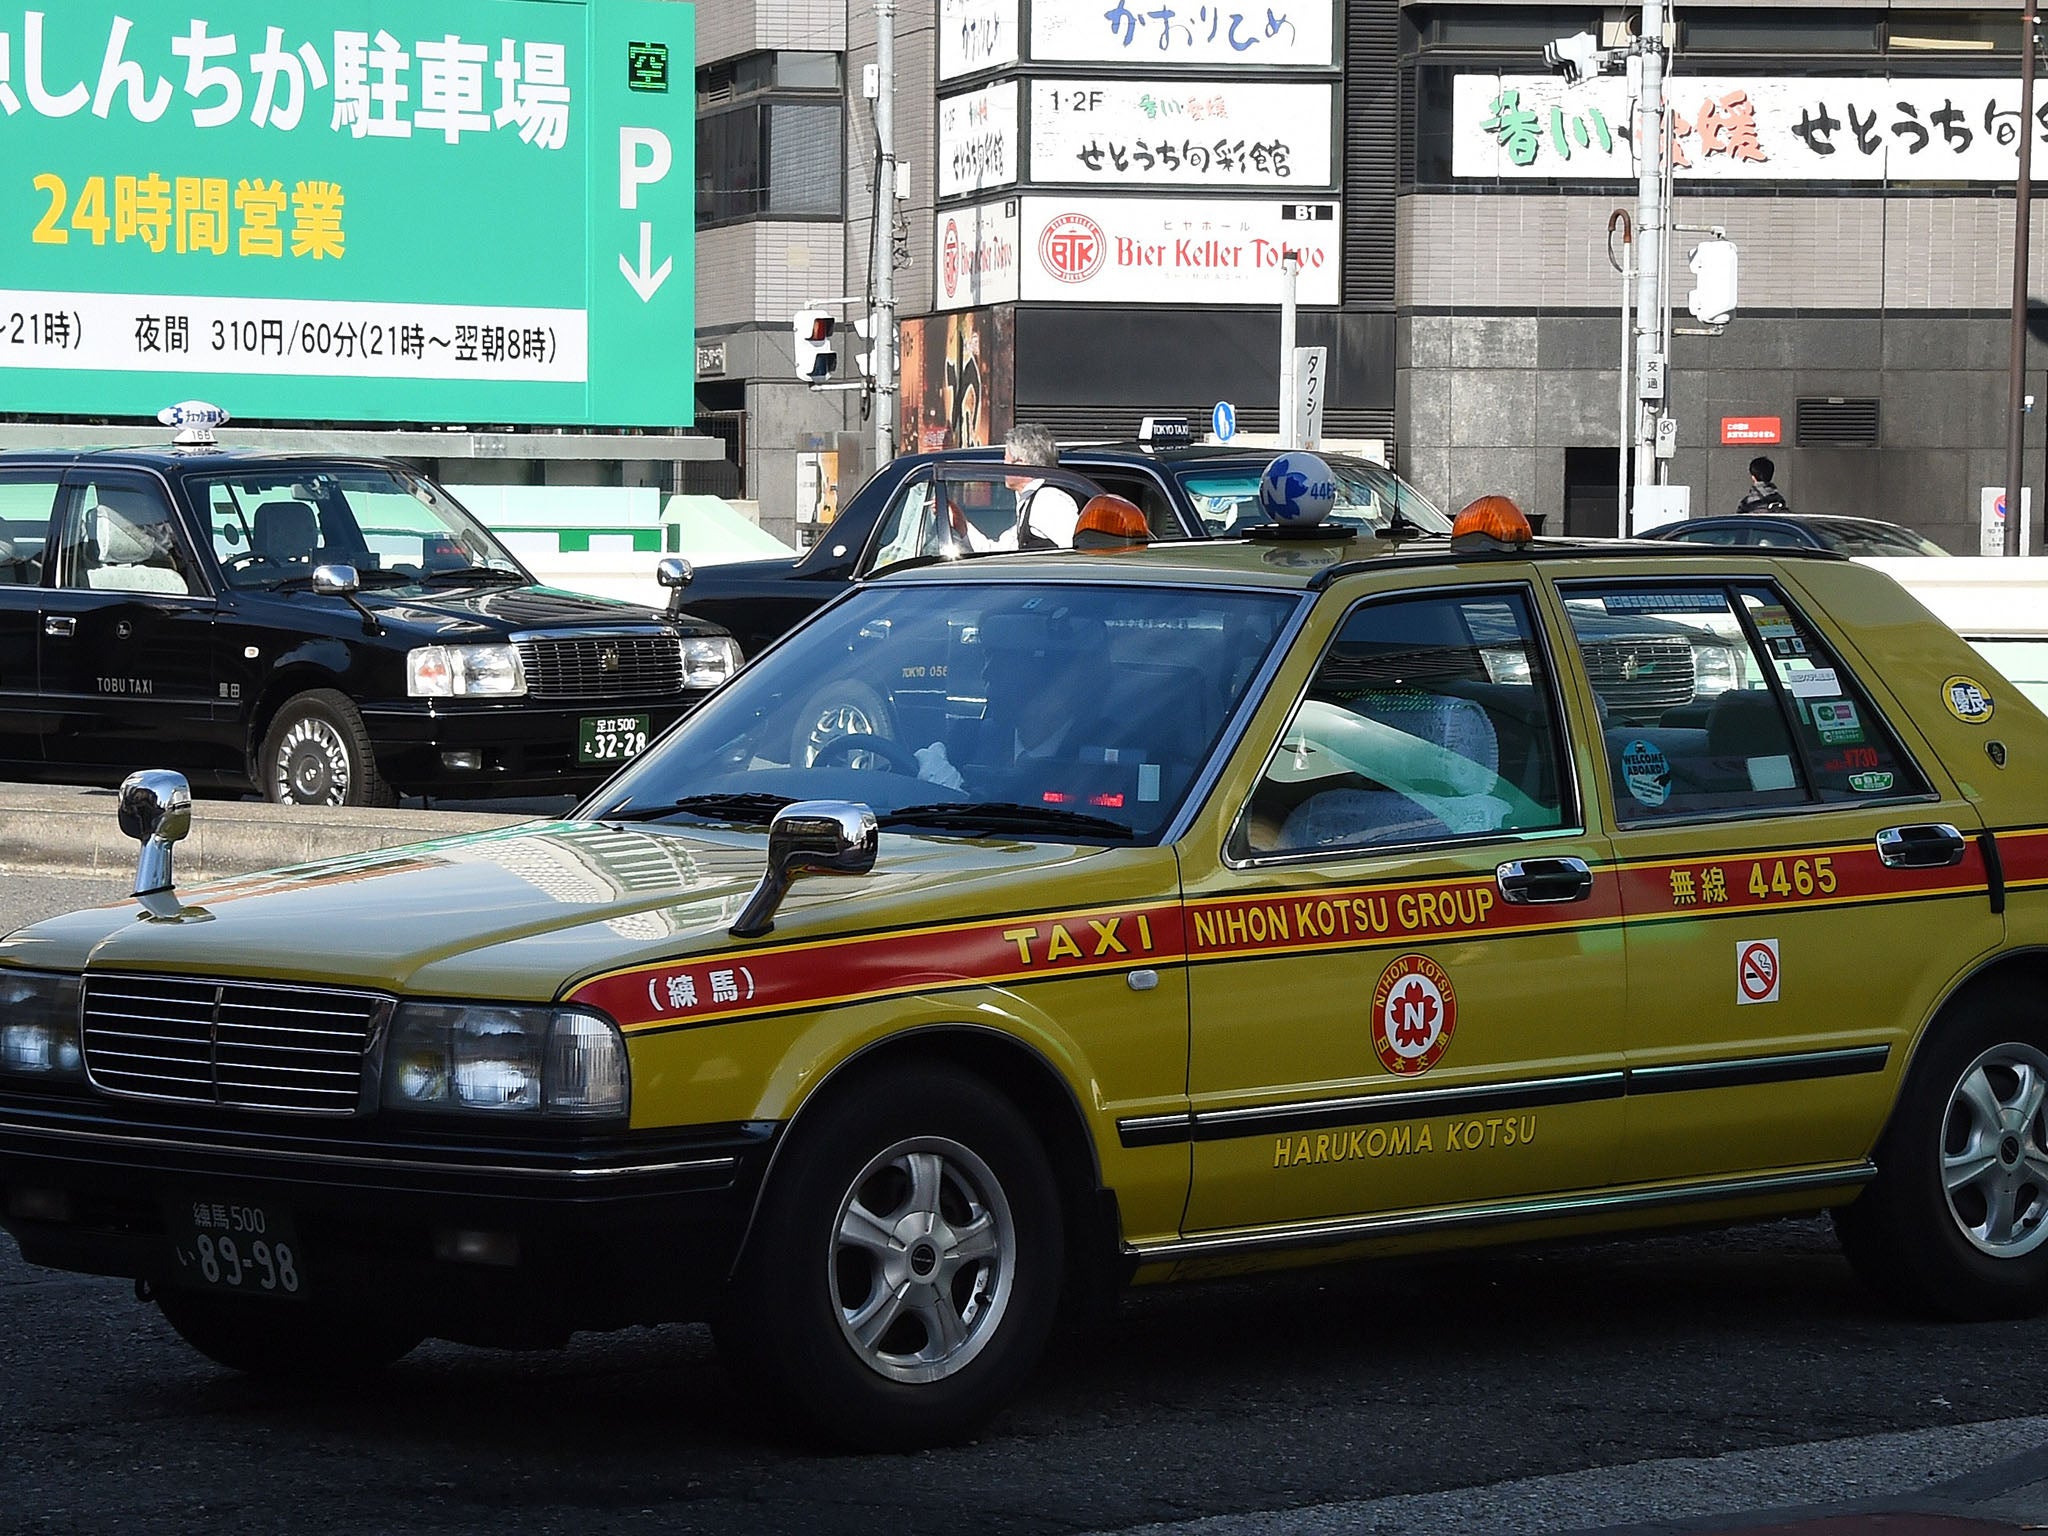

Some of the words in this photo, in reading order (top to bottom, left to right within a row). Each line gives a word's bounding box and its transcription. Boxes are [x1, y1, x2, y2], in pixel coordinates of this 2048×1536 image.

[1104, 0, 1296, 51] かおりひめ
[0, 11, 570, 150] しんちか駐車場
[629, 42, 666, 89] 空
[619, 127, 672, 209] P
[1077, 139, 1291, 177] せとうち旬彩館
[31, 173, 345, 260] 24時間営業
[1295, 204, 1317, 221] B1
[1115, 236, 1166, 267] Bier
[1176, 238, 1242, 268] Keller
[135, 314, 189, 353] 夜間
[1647, 361, 1658, 389] 交通
[1307, 355, 1319, 437] タクシー
[1153, 424, 1174, 435] TOKYO
[1174, 423, 1189, 435] TAXI
[97, 677, 126, 693] TOBU
[129, 678, 153, 694] TAXI
[902, 667, 926, 678] TOKYO
[1950, 686, 1988, 714] 優良
[594, 731, 647, 759] 32-28
[1623, 752, 1665, 765] WELCOME
[1627, 763, 1665, 776] ABOARD!
[1669, 866, 1729, 906] 無線
[1748, 857, 1837, 899] 4465
[1193, 906, 1289, 947] NIHON
[1296, 897, 1389, 938] KOTSU
[1397, 888, 1495, 929] GROUP
[1003, 914, 1154, 964] TAXI
[1375, 959, 1409, 1008] NIHON
[1417, 959, 1453, 1003] KOTSU
[1404, 1001, 1425, 1031] N
[1377, 1031, 1450, 1071] 日本交通
[1273, 1123, 1433, 1168] HARUKOMA
[1446, 1115, 1537, 1151] KOTSU
[197, 1233, 299, 1292] 89-98
